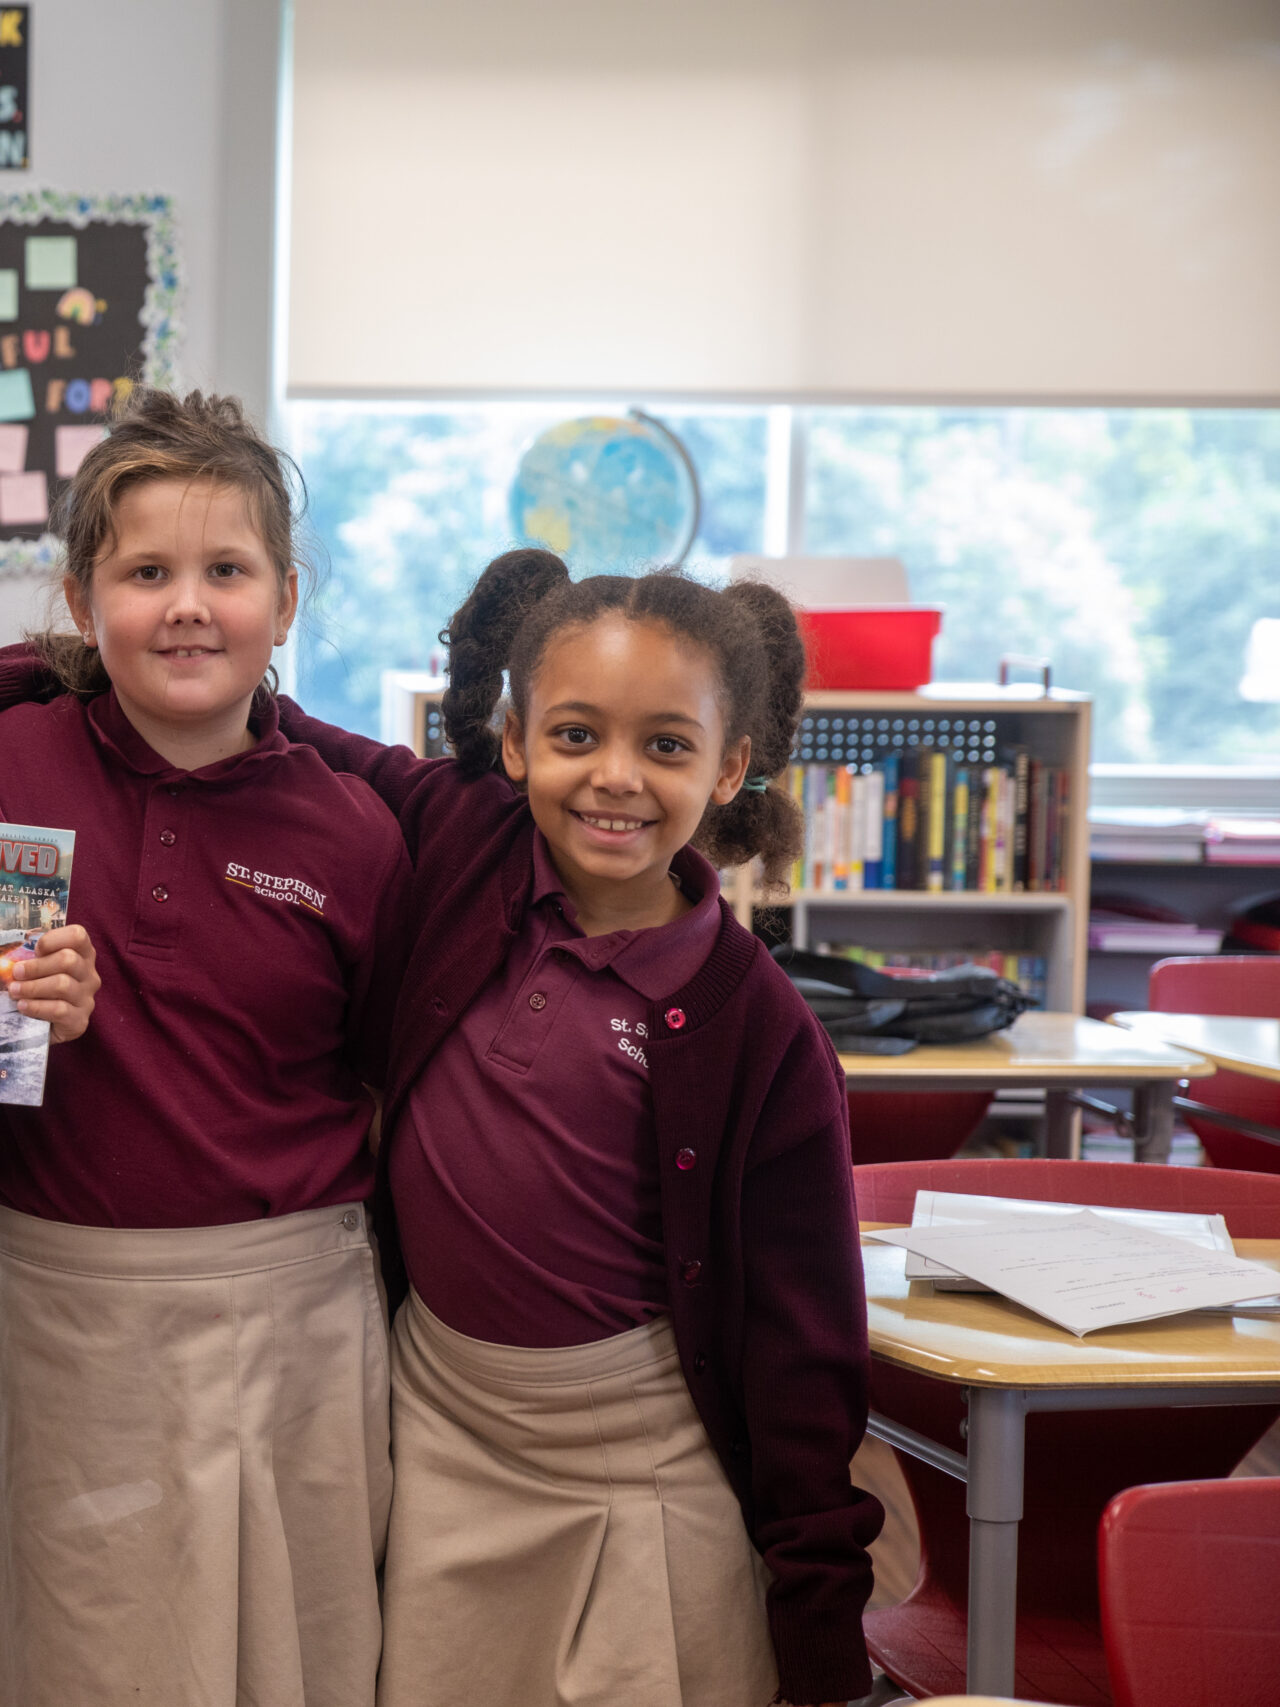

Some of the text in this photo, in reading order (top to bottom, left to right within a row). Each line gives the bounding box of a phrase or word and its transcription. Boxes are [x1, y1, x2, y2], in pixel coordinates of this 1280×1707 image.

[18, 886, 57, 898] ALASKA
[226, 862, 327, 909] ST. STEPHEN
[254, 885, 300, 905] SCHOOL
